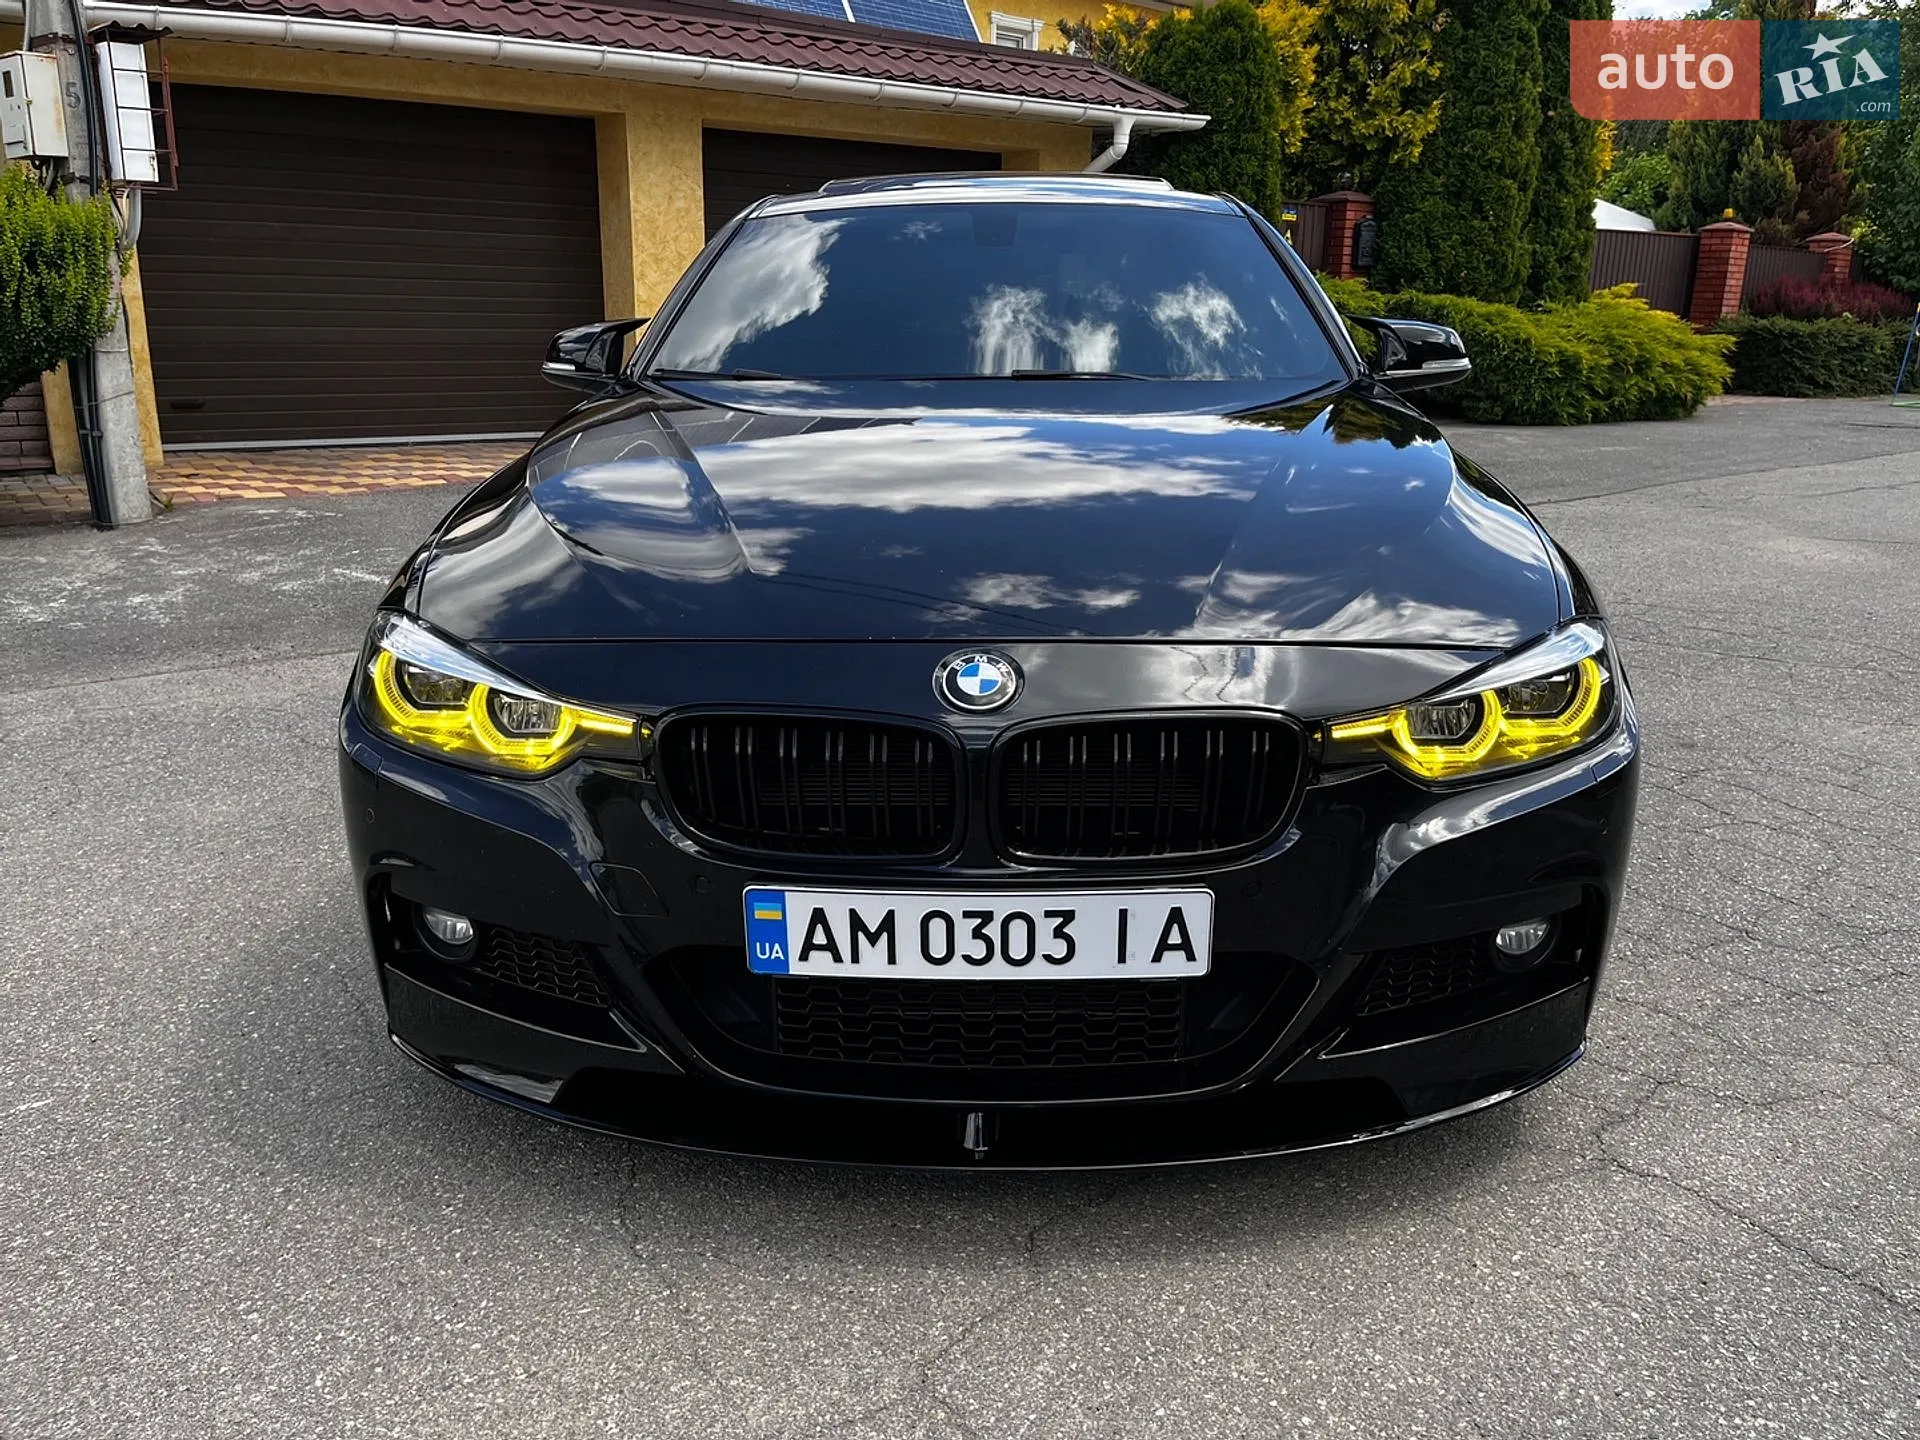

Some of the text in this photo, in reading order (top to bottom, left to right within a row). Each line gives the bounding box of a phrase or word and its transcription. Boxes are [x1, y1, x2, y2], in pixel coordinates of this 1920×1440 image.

[66, 82, 81, 109] 5
[951, 655, 1009, 672] BMW
[798, 906, 897, 965] AM
[919, 908, 1076, 967] 0303
[755, 942, 785, 961] UA
